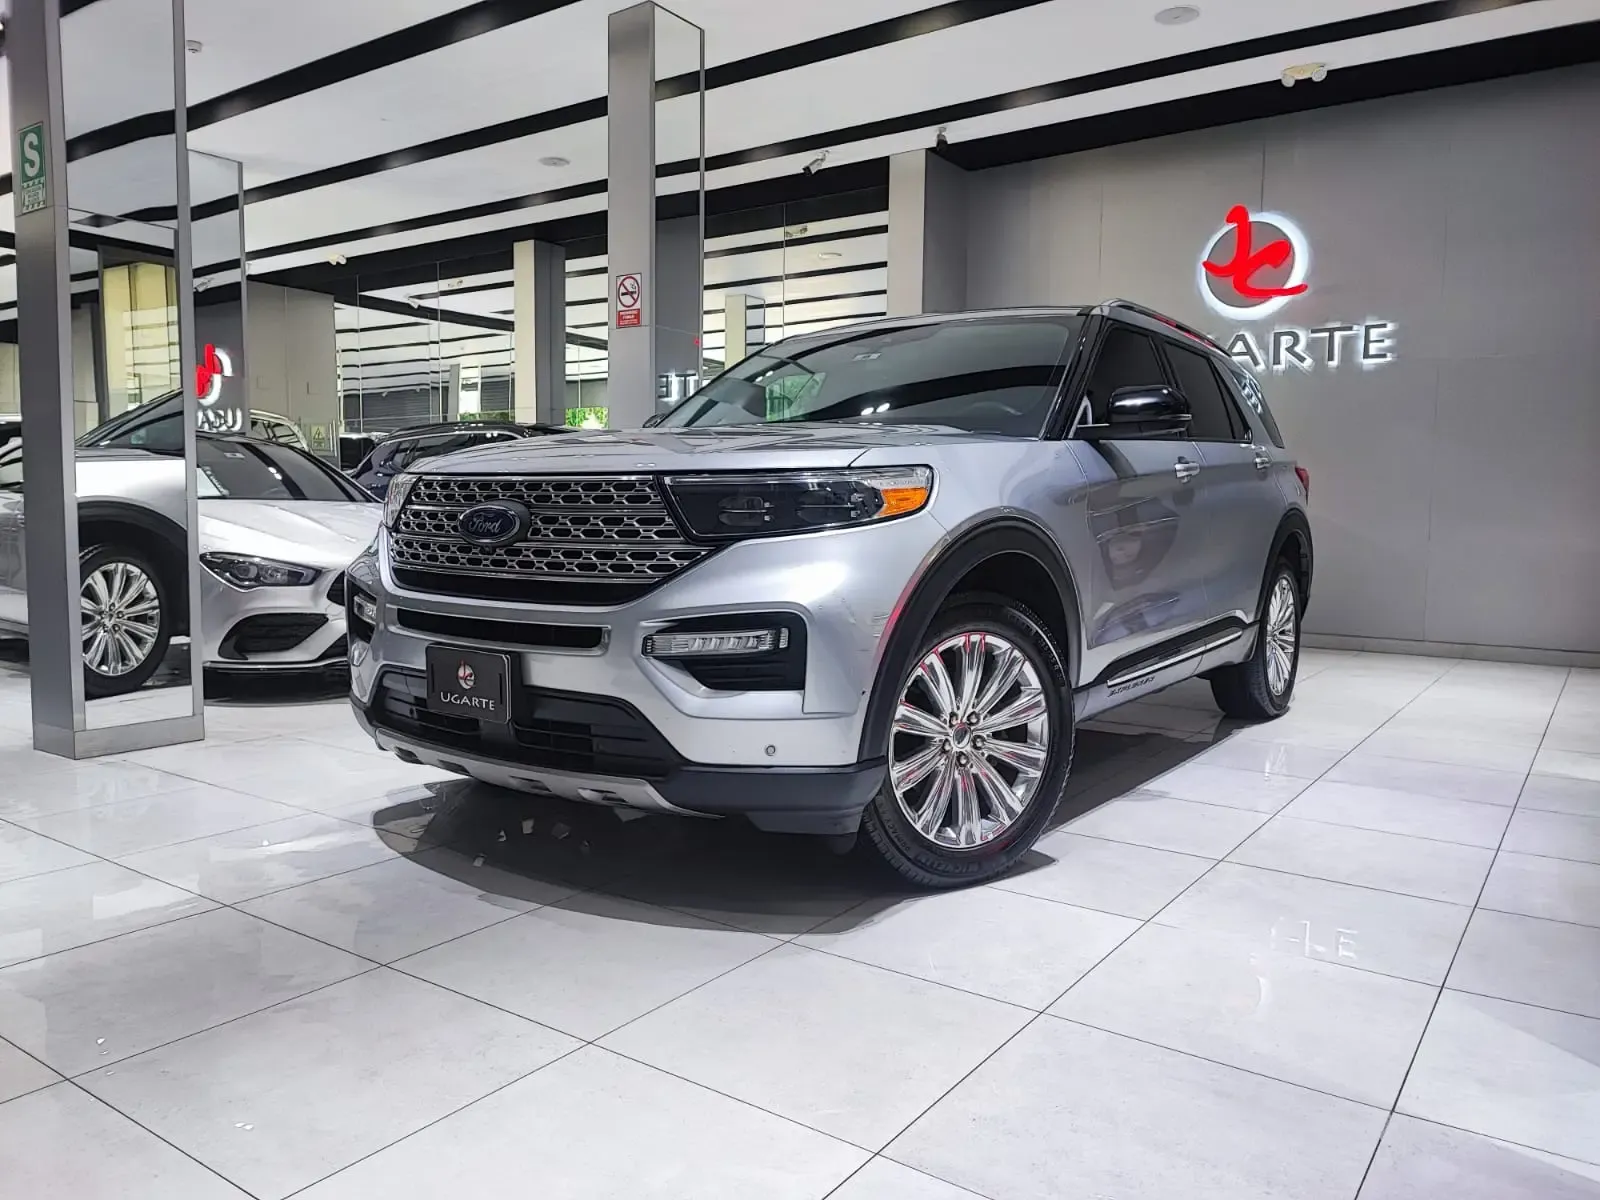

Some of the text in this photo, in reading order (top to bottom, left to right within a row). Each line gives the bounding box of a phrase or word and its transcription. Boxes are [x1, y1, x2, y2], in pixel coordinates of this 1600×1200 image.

[23, 132, 41, 178] S
[1224, 321, 1392, 370] ARTE
[468, 511, 503, 534] Ford
[440, 691, 496, 711] UGARTE
